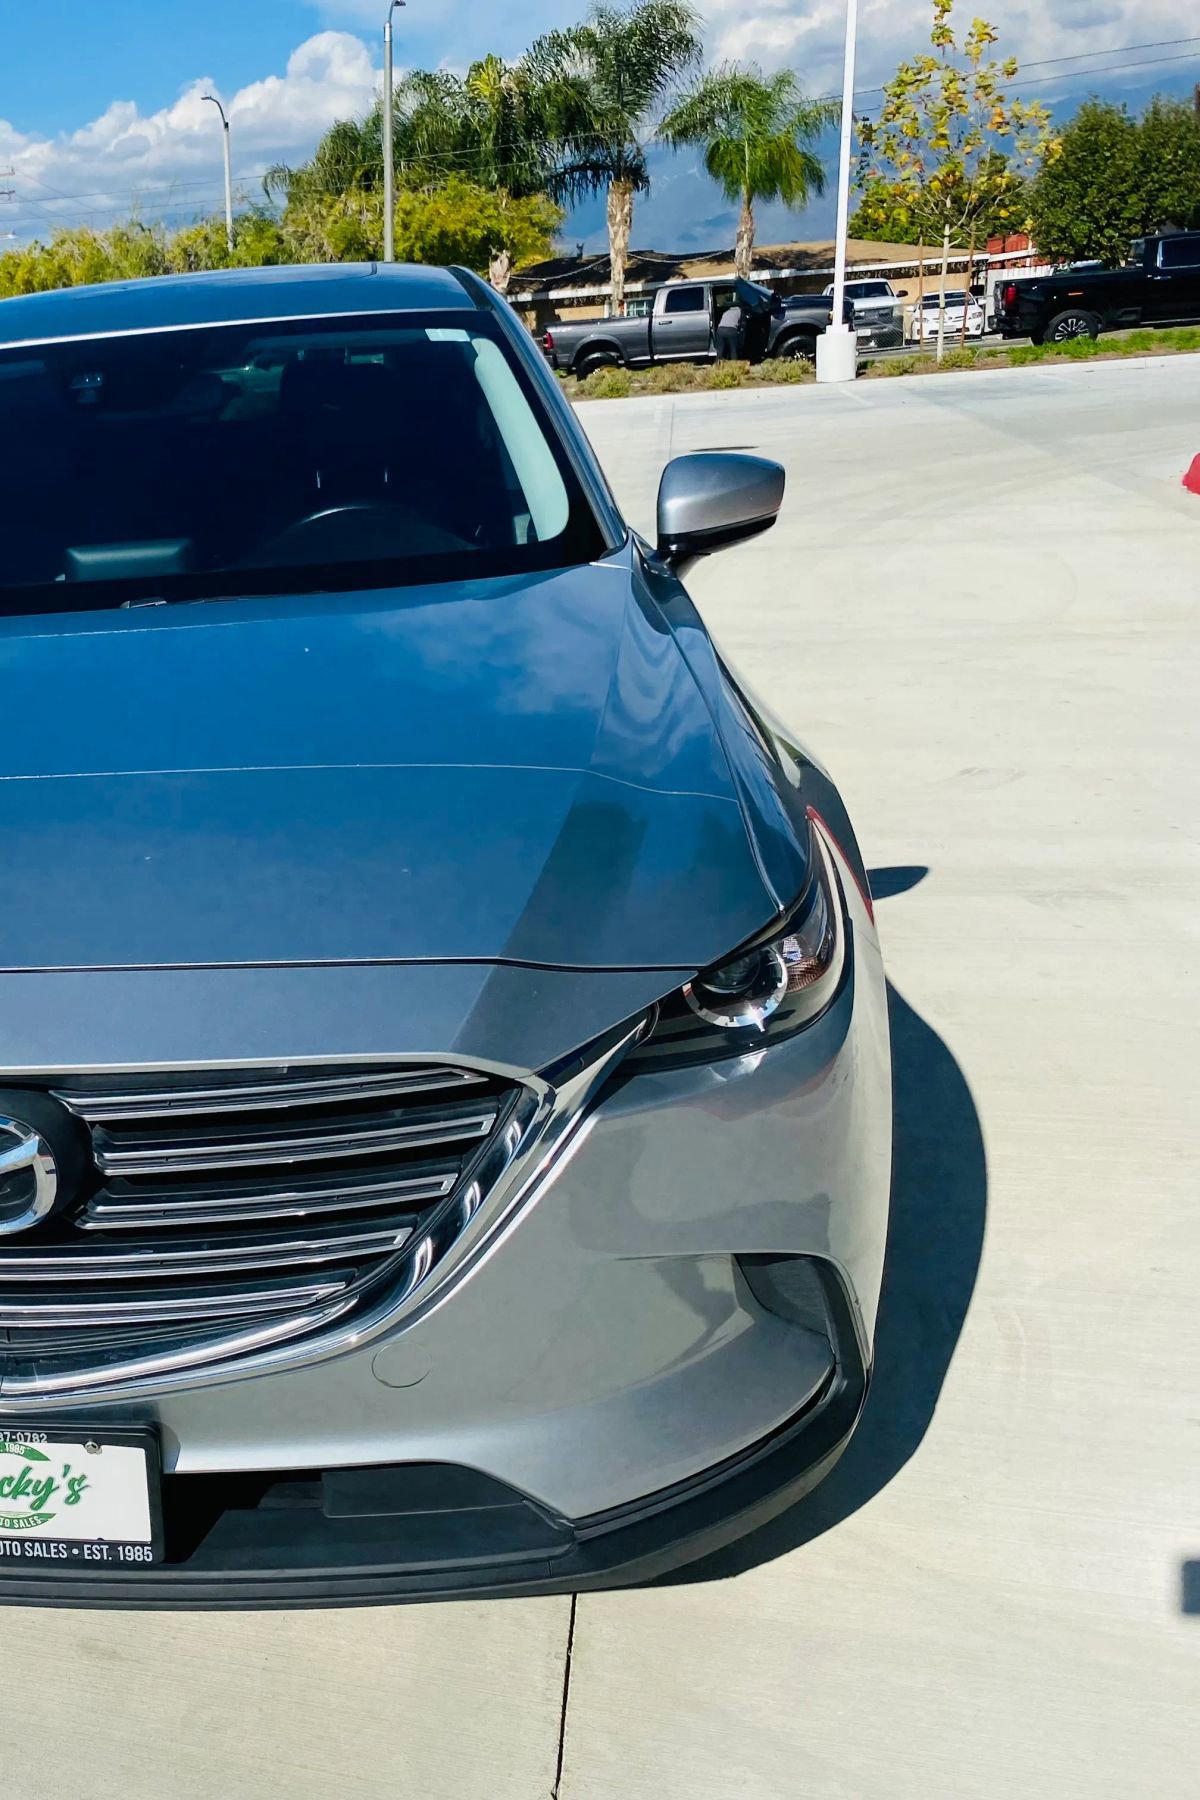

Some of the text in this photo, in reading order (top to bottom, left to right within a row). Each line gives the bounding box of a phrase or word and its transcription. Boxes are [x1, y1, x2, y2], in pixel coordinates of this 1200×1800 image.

[5, 1443, 26, 1455] 1985
[13, 1515, 41, 1529] SALES
[25, 1541, 67, 1559] SALES
[83, 1546, 113, 1561] EST.
[117, 1546, 153, 1562] 1985
